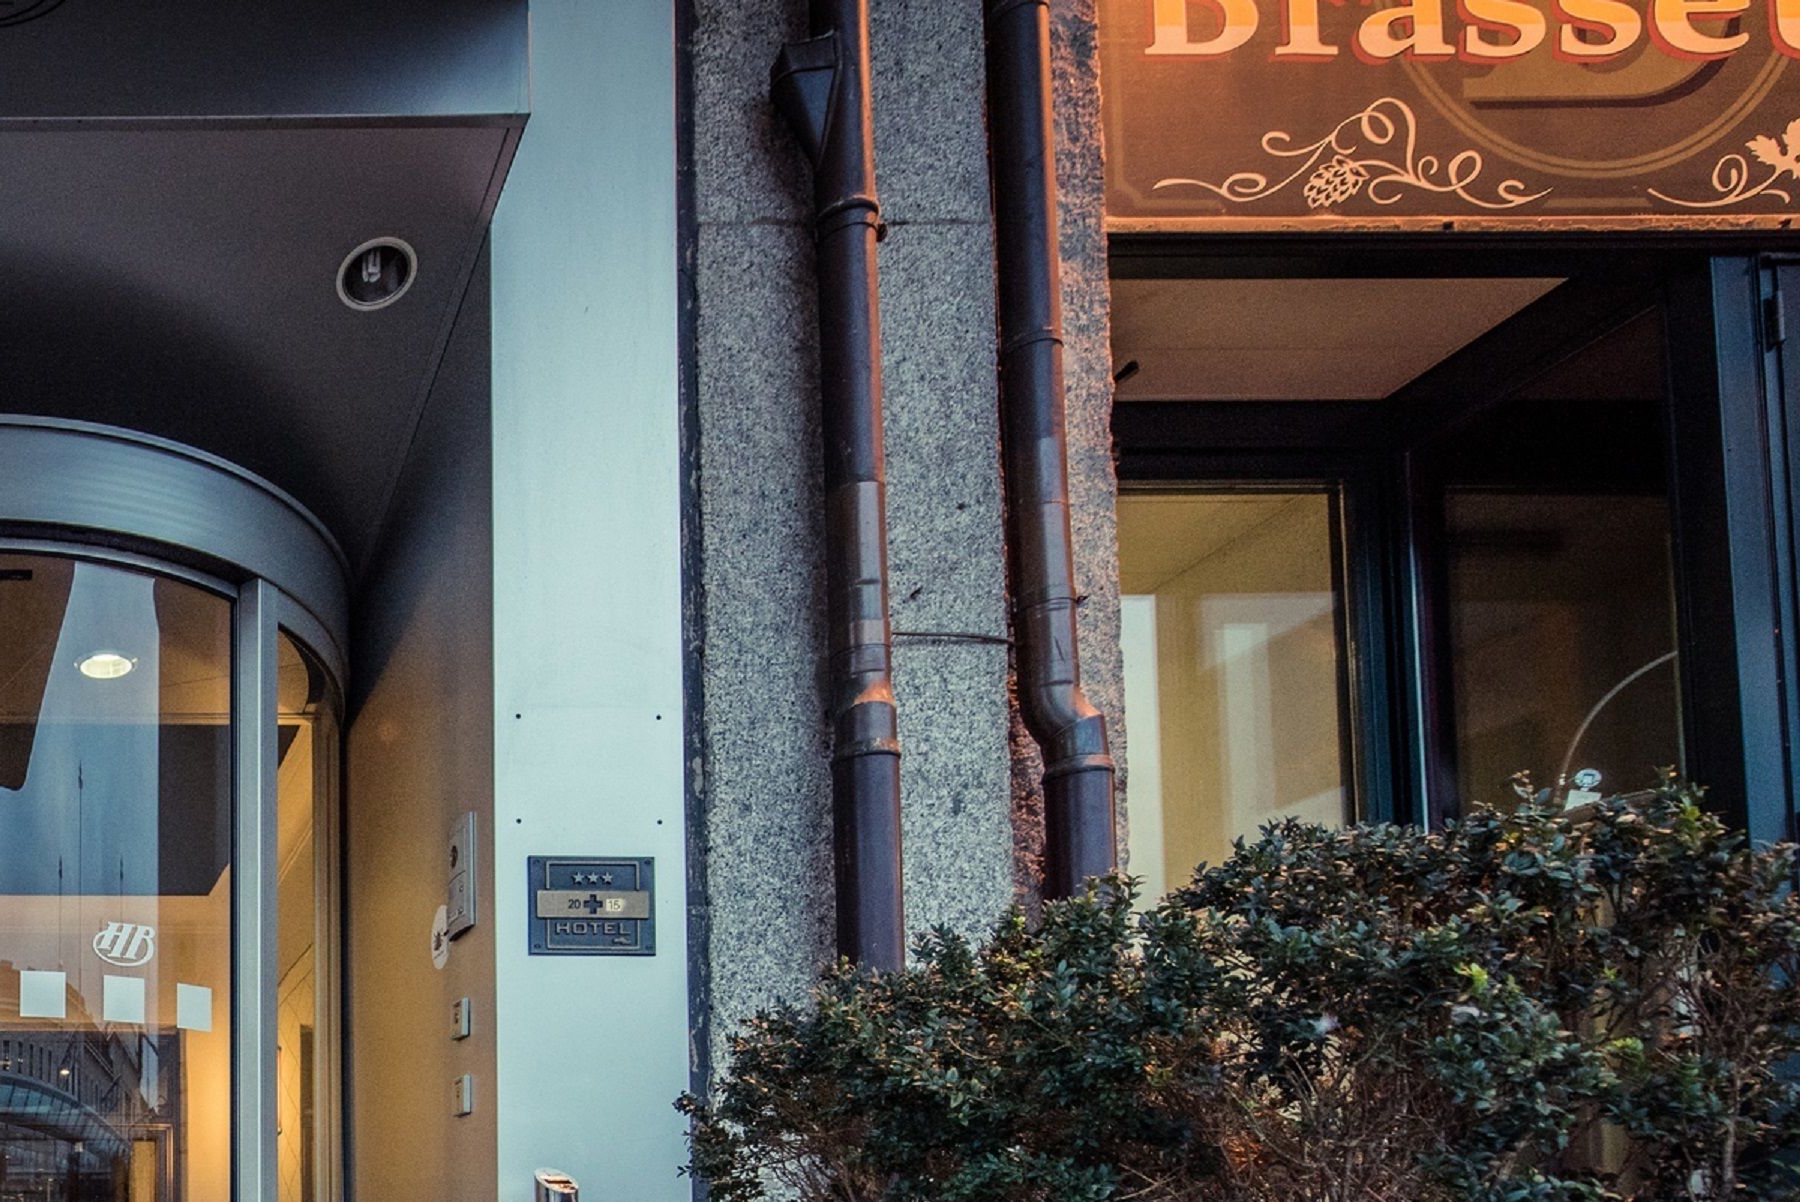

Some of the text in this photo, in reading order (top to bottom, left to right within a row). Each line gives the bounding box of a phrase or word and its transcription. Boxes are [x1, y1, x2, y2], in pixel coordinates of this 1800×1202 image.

[1142, 0, 1800, 58] Brasse
[568, 898, 621, 911] 20 15
[555, 922, 632, 935] HOTEL
[92, 921, 156, 967] HB
